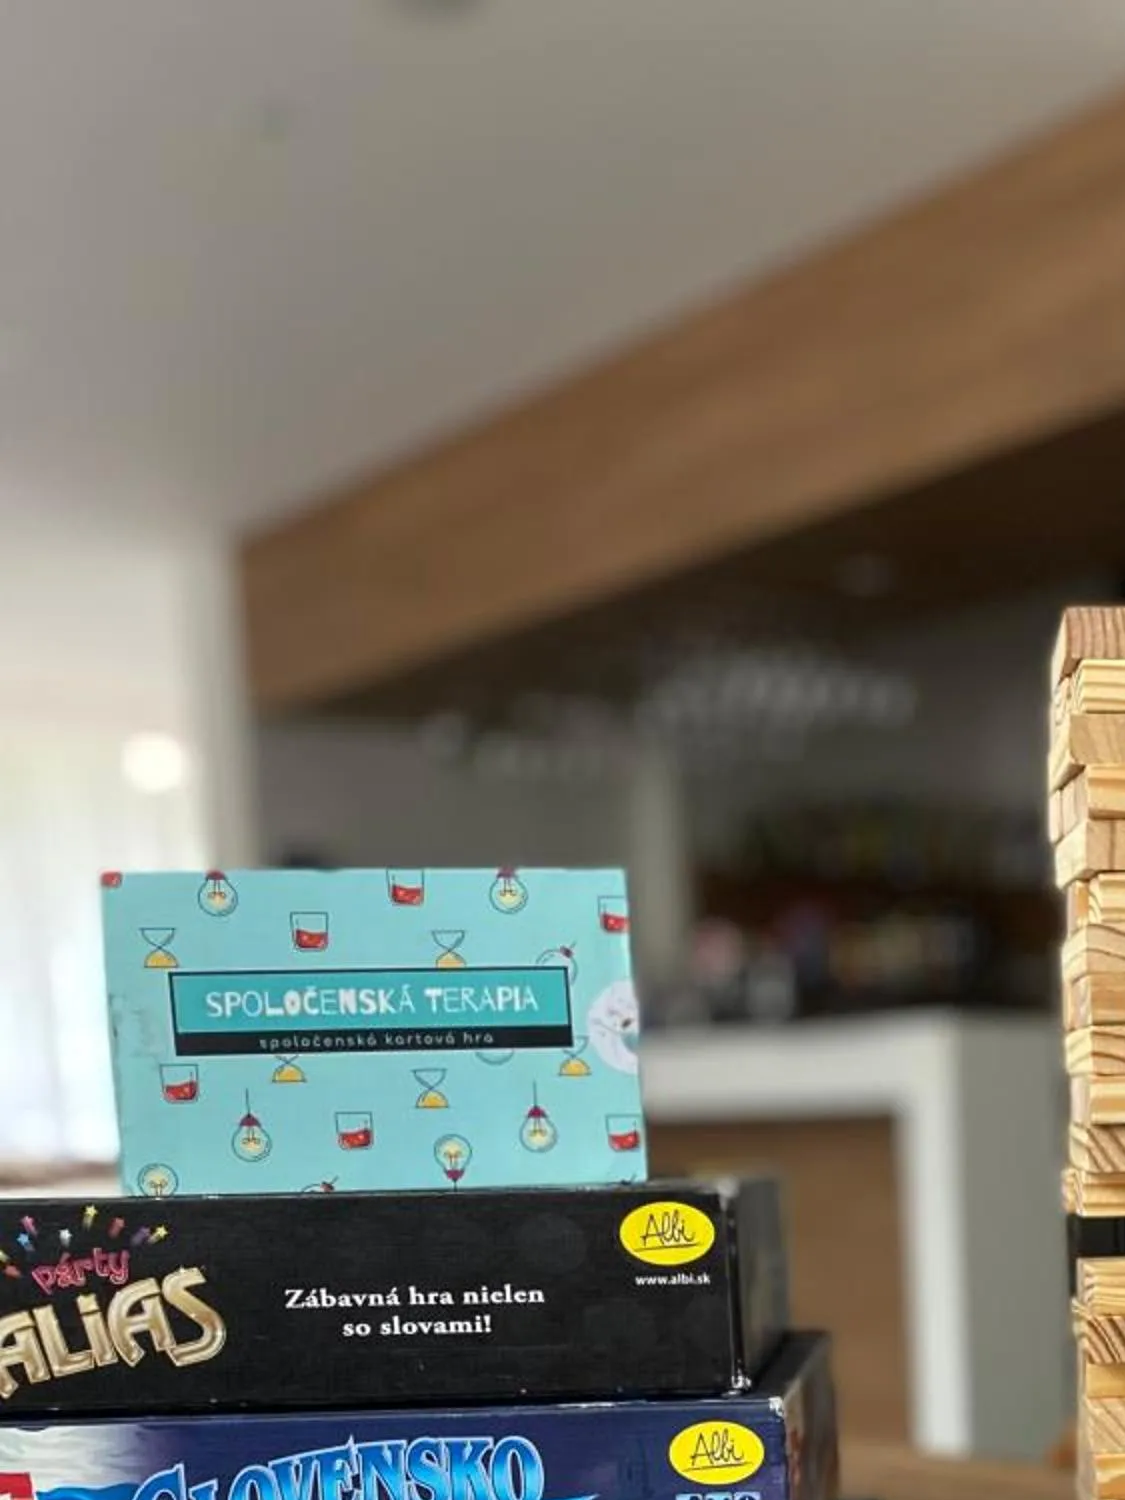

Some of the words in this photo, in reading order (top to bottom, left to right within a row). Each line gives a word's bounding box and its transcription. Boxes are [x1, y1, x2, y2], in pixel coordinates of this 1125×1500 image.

[206, 984, 416, 1018] SPOLOČENSKÁ
[424, 984, 539, 1014] TERAPIA
[385, 1031, 456, 1047] kartová
[463, 1031, 495, 1045] hra
[640, 1208, 697, 1248] Albi
[635, 1272, 711, 1286] www.albi.sk
[284, 1286, 400, 1309] Zábavná
[408, 1286, 455, 1306] hra
[463, 1283, 546, 1304] nielen
[342, 1321, 372, 1337] so
[379, 1315, 493, 1336] slovami!
[689, 1427, 745, 1467] Albi
